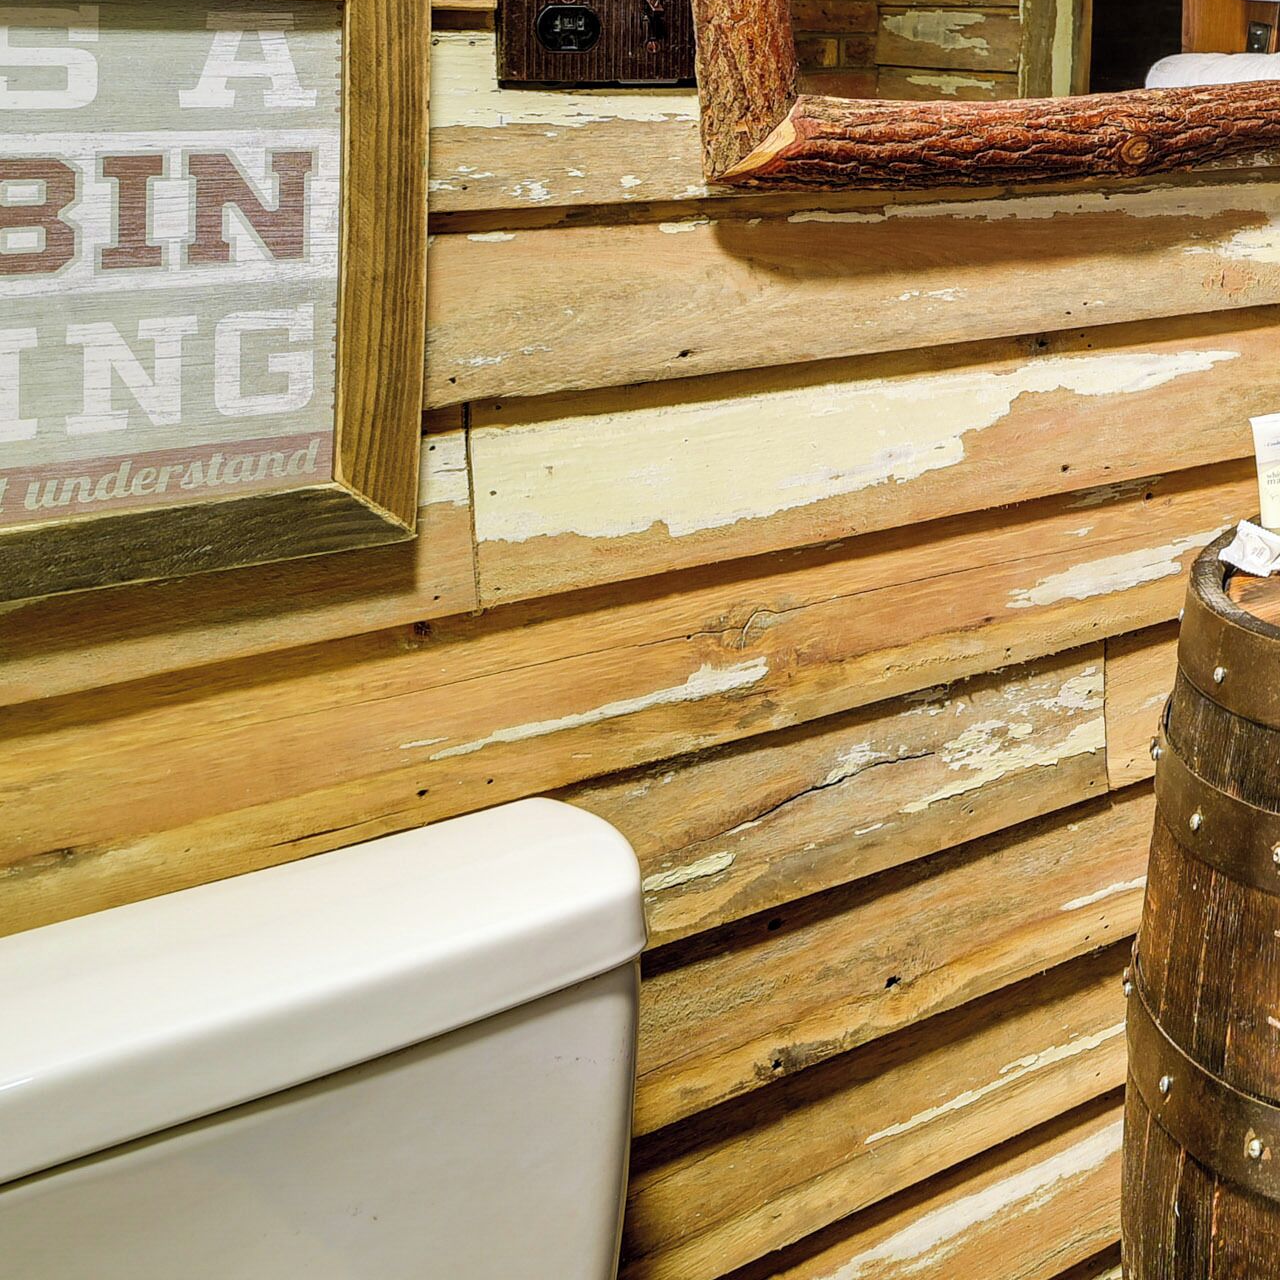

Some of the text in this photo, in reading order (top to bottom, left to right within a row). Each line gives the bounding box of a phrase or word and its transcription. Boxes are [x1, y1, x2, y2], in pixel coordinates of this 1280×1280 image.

[178, 11, 318, 109] A
[0, 149, 319, 277] BIN
[24, 438, 322, 510] understand
